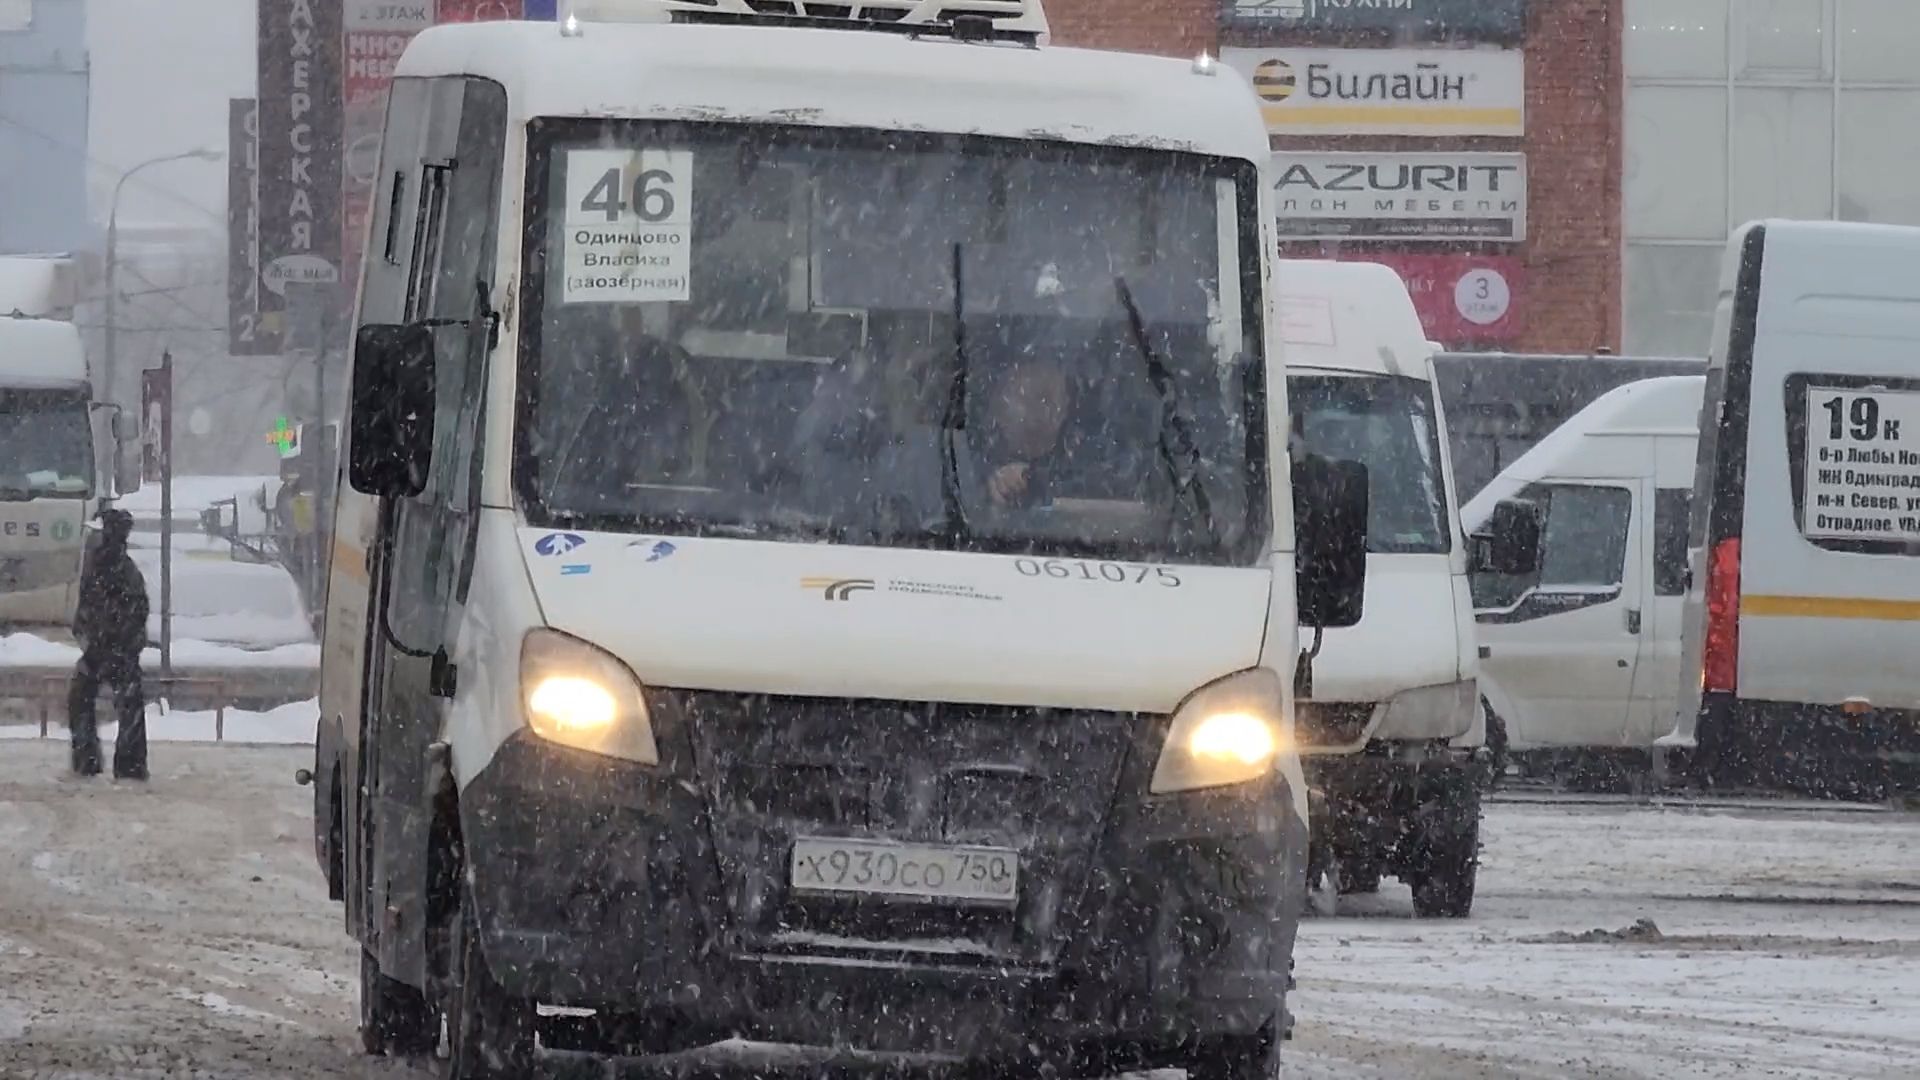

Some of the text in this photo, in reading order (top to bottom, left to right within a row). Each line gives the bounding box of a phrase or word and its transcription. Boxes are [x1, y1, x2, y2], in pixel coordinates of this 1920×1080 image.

[1307, 63, 1464, 100] Билайн
[1273, 163, 1518, 192] AZURIT
[580, 167, 676, 223] 46
[1374, 199, 1518, 212] МЕБЕЛИ
[574, 230, 681, 246] Одинцово
[583, 252, 672, 267] Власиха
[1475, 277, 1489, 300] 3
[1819, 446, 1843, 464] б-р
[1847, 447, 1895, 465] Любы
[1817, 493, 1845, 508] м-н
[1898, 516, 1920, 534] УВ
[1014, 557, 1181, 588] 061075
